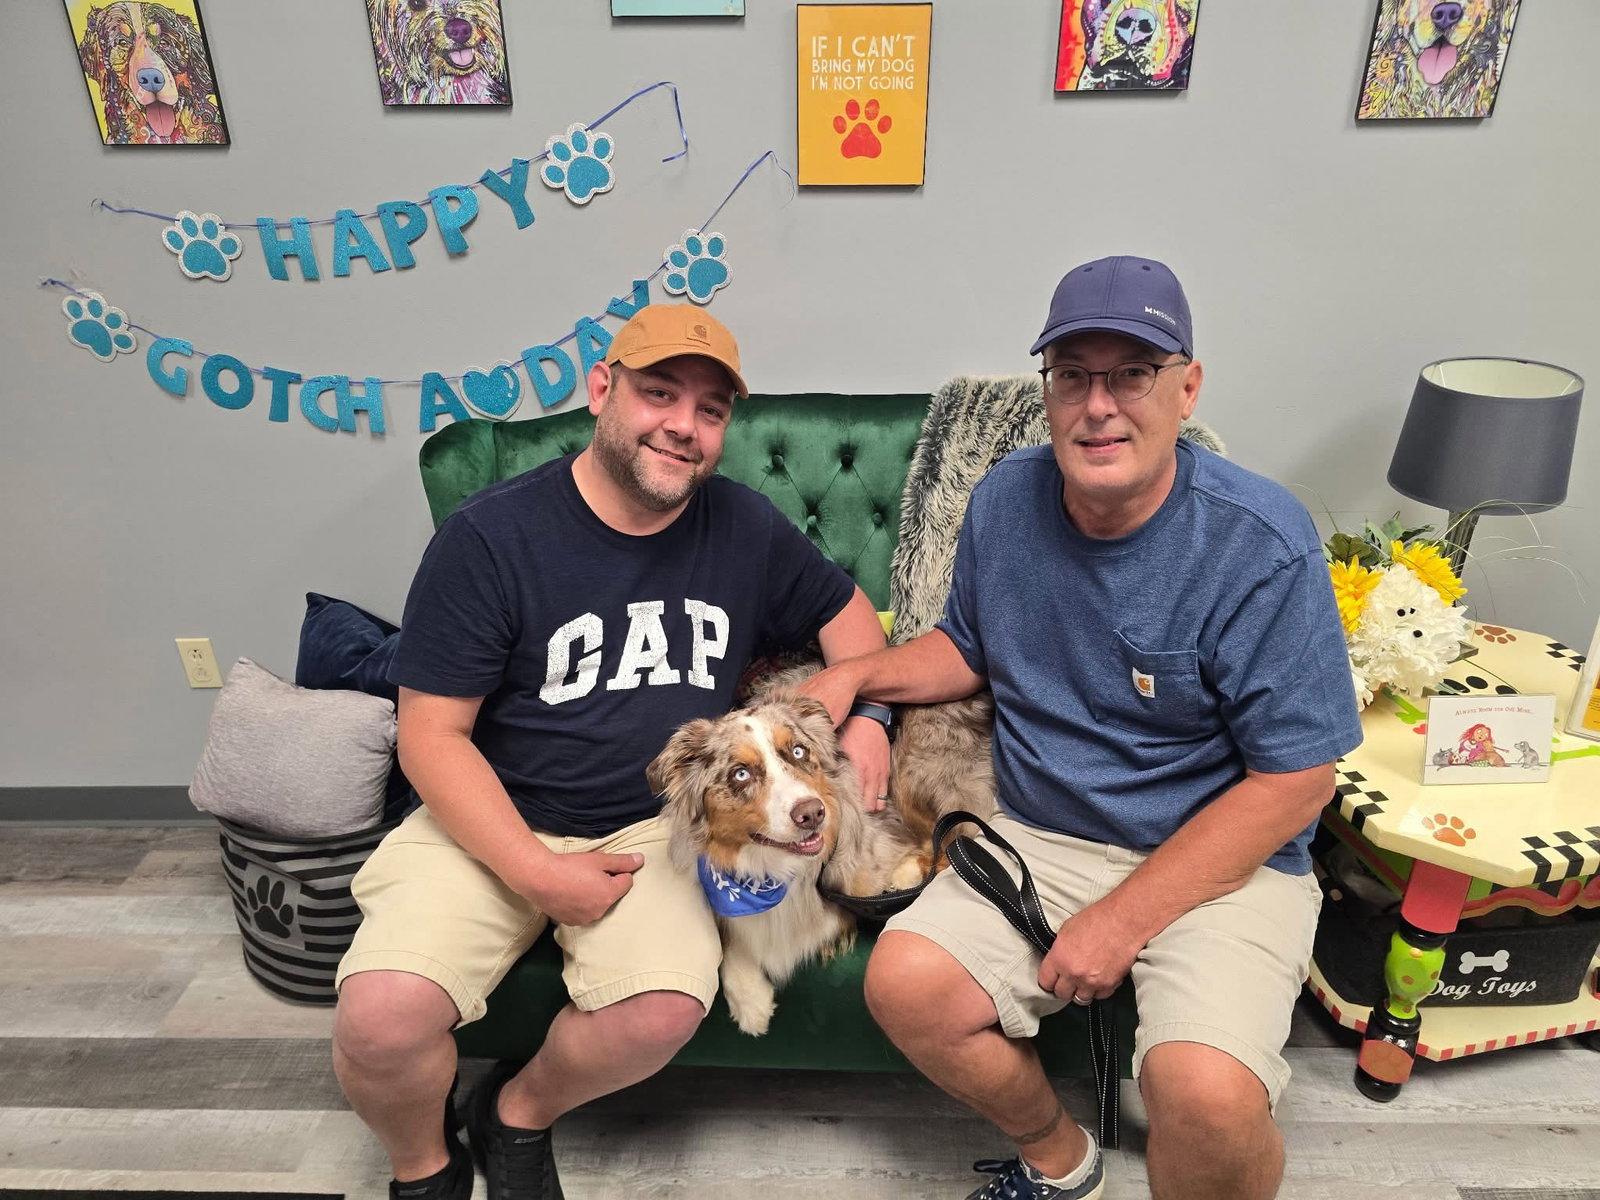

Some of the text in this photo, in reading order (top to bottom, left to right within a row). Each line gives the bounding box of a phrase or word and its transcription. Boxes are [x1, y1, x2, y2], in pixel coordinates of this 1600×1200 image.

[812, 33, 915, 57] IF I CAN'T
[812, 58, 914, 73] BRING MY DOG
[811, 74, 914, 90] I'M NOT GOING
[256, 157, 535, 281] HAPPY
[539, 598, 730, 706] GAP
[1477, 976, 1537, 998] Toys
